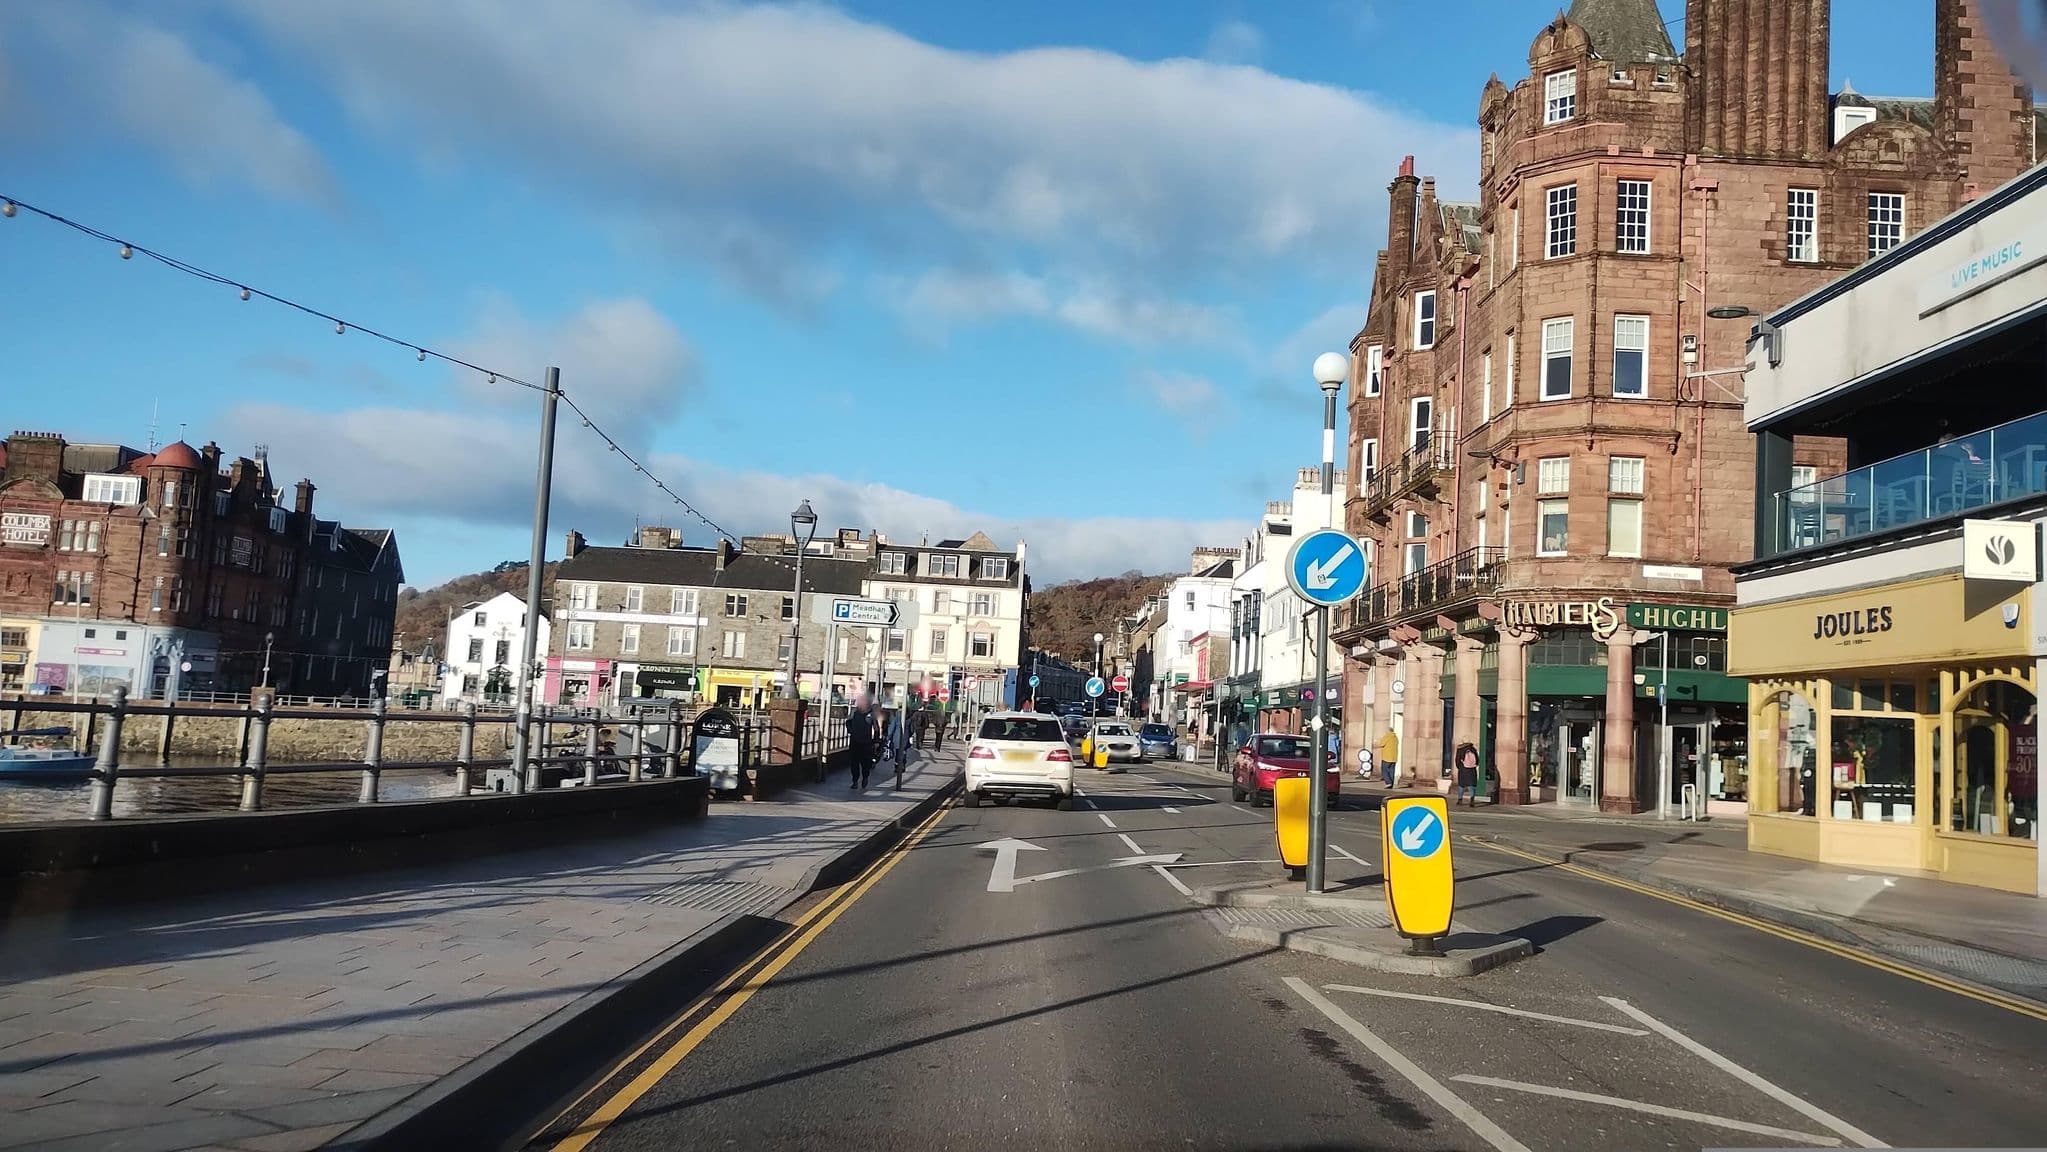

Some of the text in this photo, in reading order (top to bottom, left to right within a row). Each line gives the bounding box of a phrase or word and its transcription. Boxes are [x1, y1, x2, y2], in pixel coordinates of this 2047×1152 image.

[1952, 241, 2022, 289] LIVE MUSIC
[2, 515, 51, 529] COLUMBA
[6, 529, 44, 541] HOTEL
[838, 604, 886, 616] P Meadhan
[852, 611, 880, 620] Central
[1502, 597, 1618, 633] CHALMERS
[1643, 607, 1727, 630] HIGHL
[1814, 606, 1892, 640] JOULES
